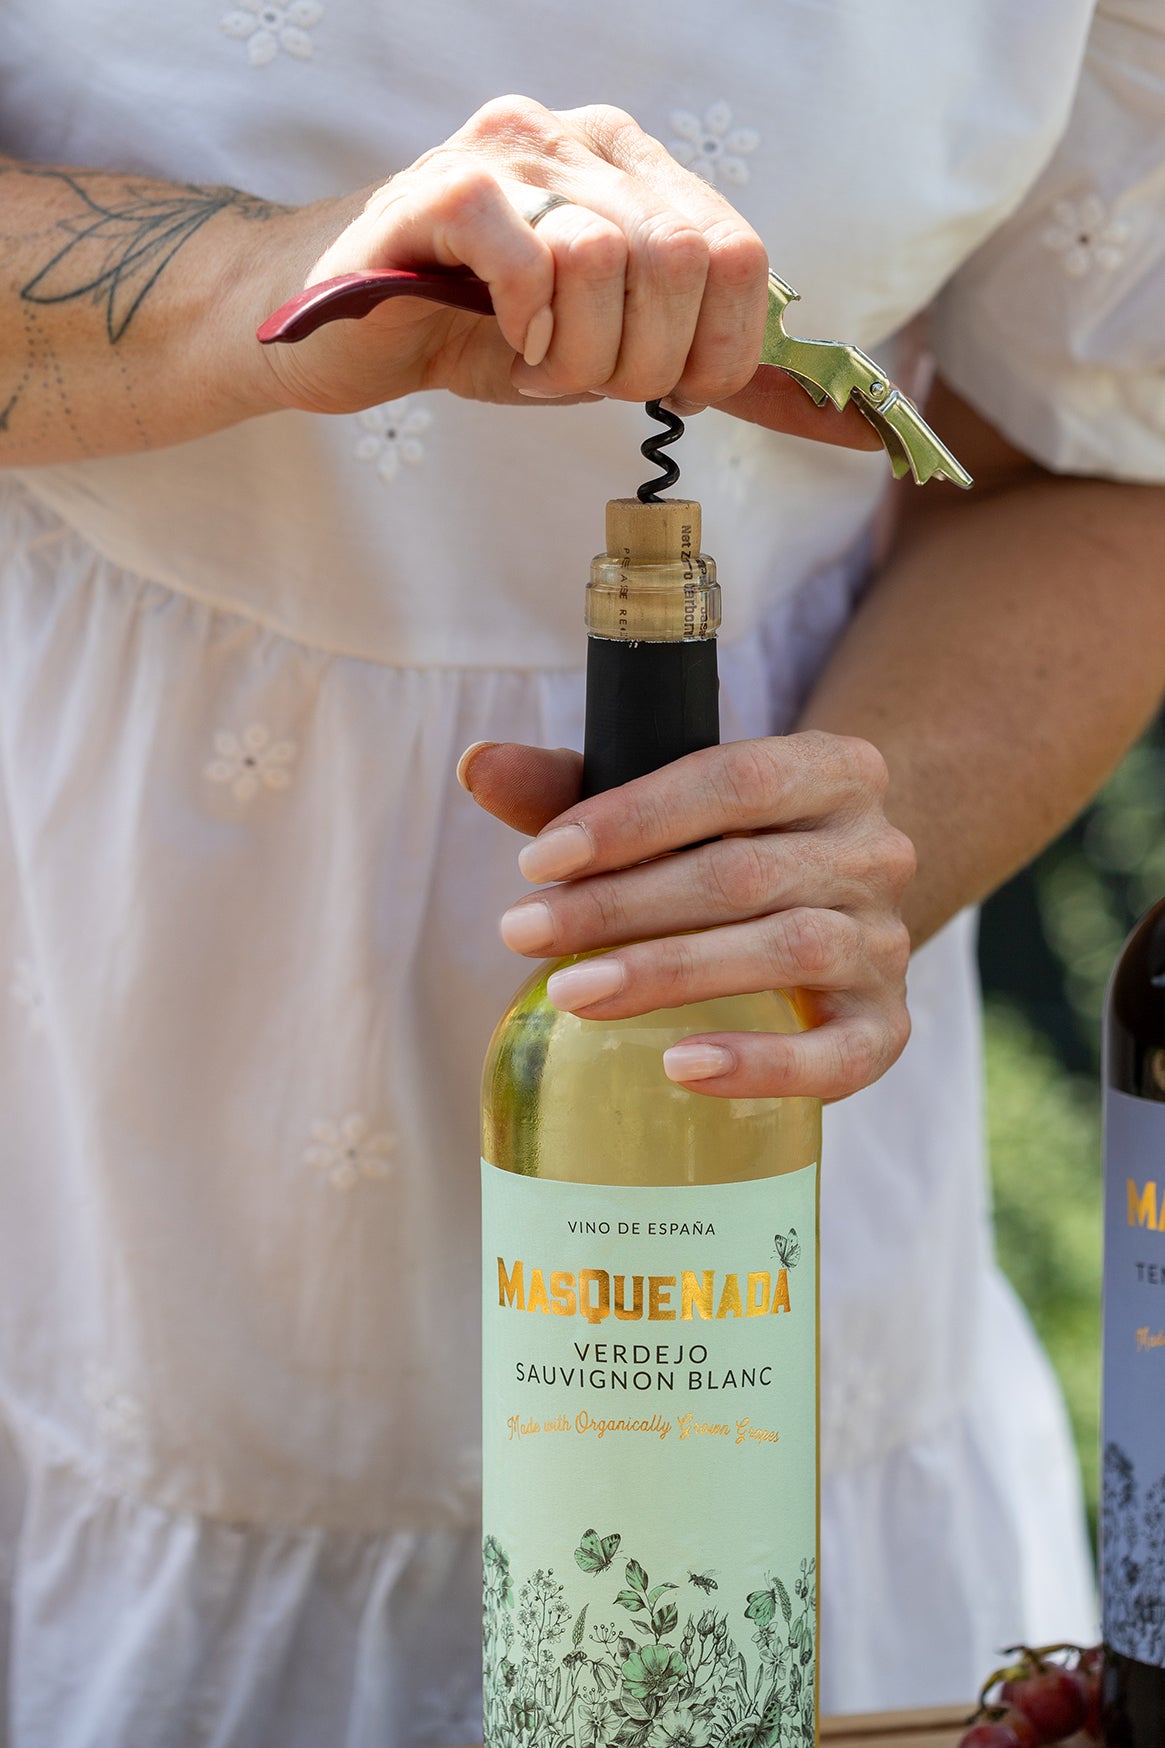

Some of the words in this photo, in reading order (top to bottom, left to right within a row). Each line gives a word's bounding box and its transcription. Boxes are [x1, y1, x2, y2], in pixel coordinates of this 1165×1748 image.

[681, 525, 692, 548] Net
[567, 1220, 611, 1235] VINO
[617, 1221, 641, 1235] DE
[647, 1220, 716, 1236] ESPAÑA
[573, 1342, 708, 1365] VERDEJO
[515, 1361, 675, 1391] SAUVIGNON
[688, 1366, 773, 1391] BLANC
[506, 1414, 541, 1441] Made
[543, 1412, 572, 1433] with
[574, 1409, 673, 1440] Organically
[676, 1411, 731, 1441] Grown
[734, 1416, 780, 1445] Grapes
